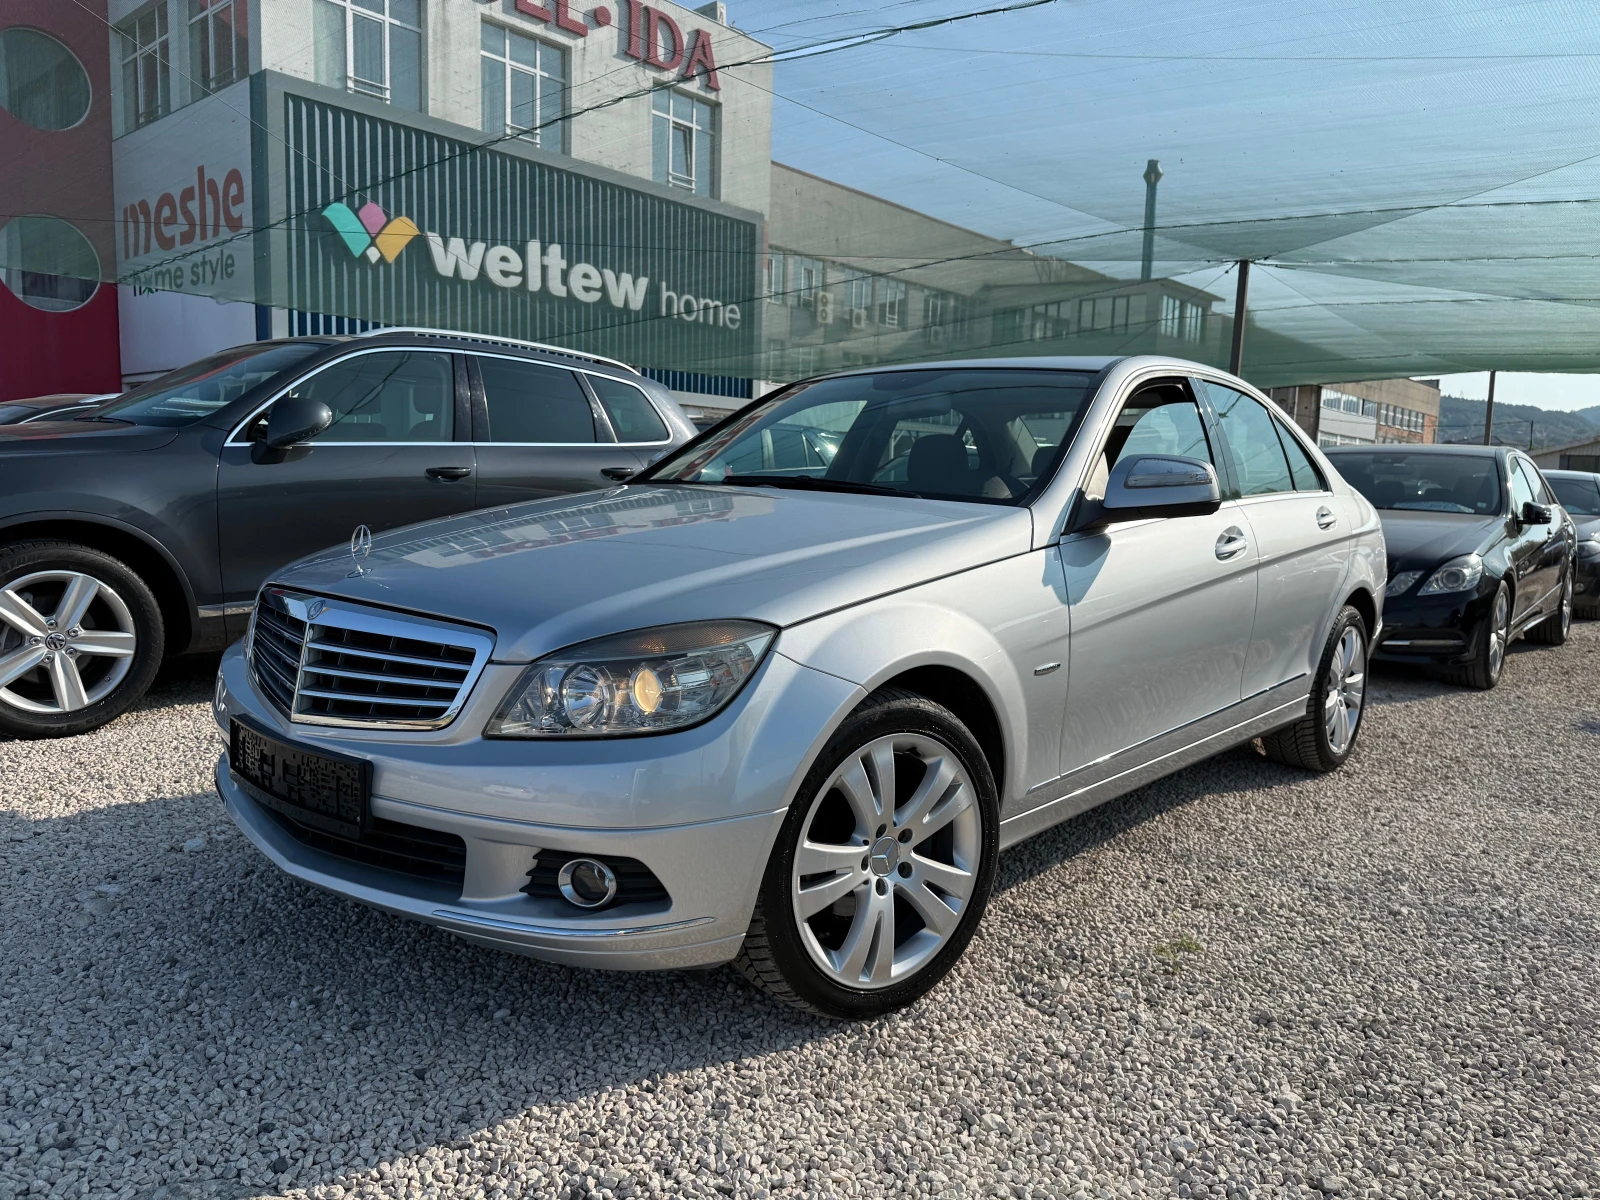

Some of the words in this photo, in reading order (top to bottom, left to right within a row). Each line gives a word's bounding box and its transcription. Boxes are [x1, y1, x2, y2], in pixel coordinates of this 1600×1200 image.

[624, 0, 721, 91] IDA
[123, 165, 244, 260] meshe
[190, 249, 235, 286] style
[426, 231, 648, 311] weltew
[660, 281, 741, 330] home
